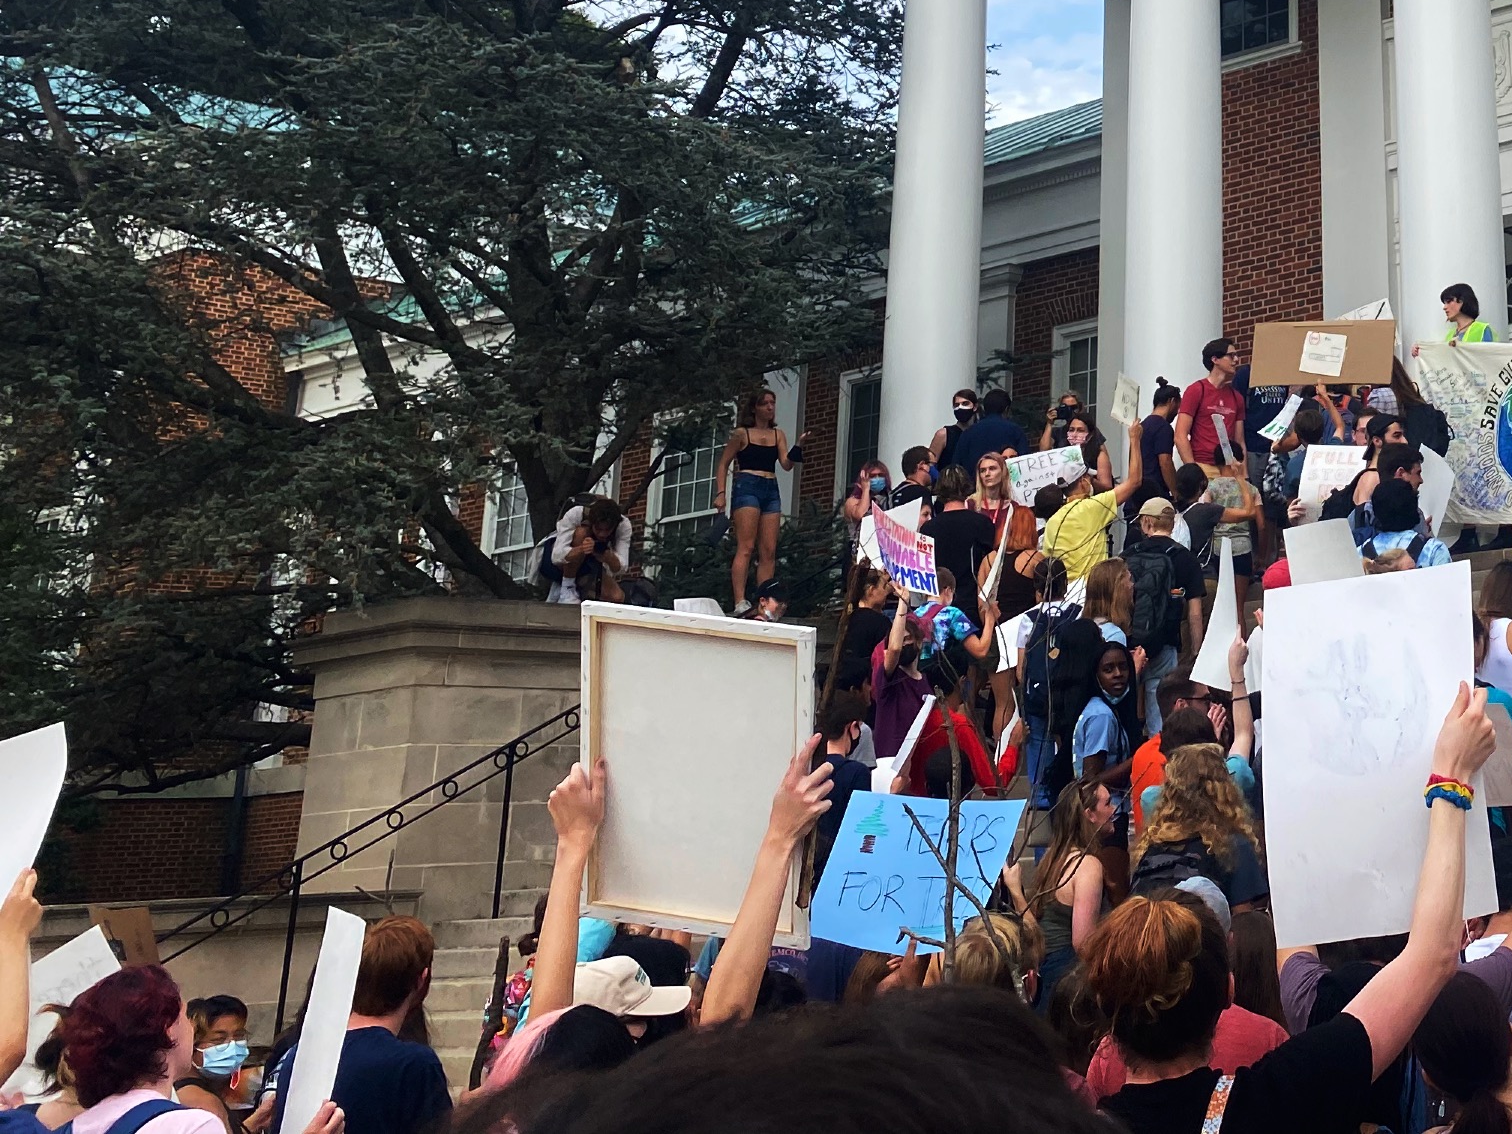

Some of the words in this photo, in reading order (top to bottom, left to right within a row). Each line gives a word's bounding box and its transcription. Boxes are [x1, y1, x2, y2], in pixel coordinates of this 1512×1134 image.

[1480, 383, 1503, 431] SAVE
[1010, 449, 1071, 475] TREES
[838, 871, 905, 914] FOR
